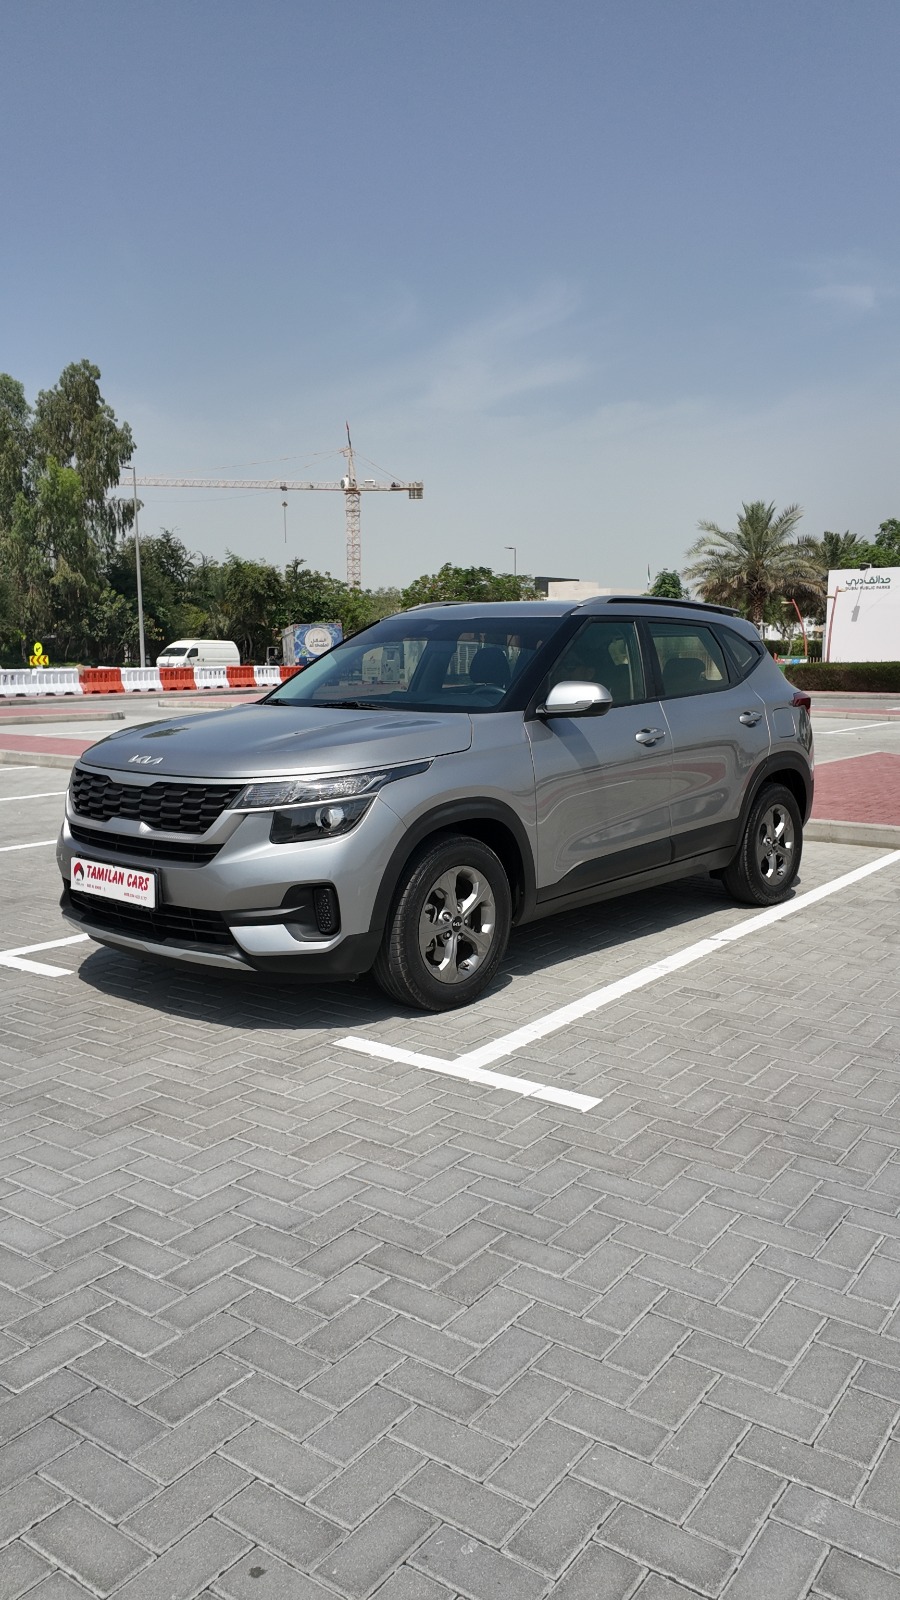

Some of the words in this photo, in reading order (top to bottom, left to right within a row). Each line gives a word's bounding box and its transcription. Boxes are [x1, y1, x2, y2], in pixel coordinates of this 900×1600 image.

[846, 578, 864, 586] دبي
[864, 575, 891, 584] حدائق
[128, 754, 163, 765] KIA
[87, 865, 125, 885] TAMILAN
[127, 873, 150, 891] CARS
